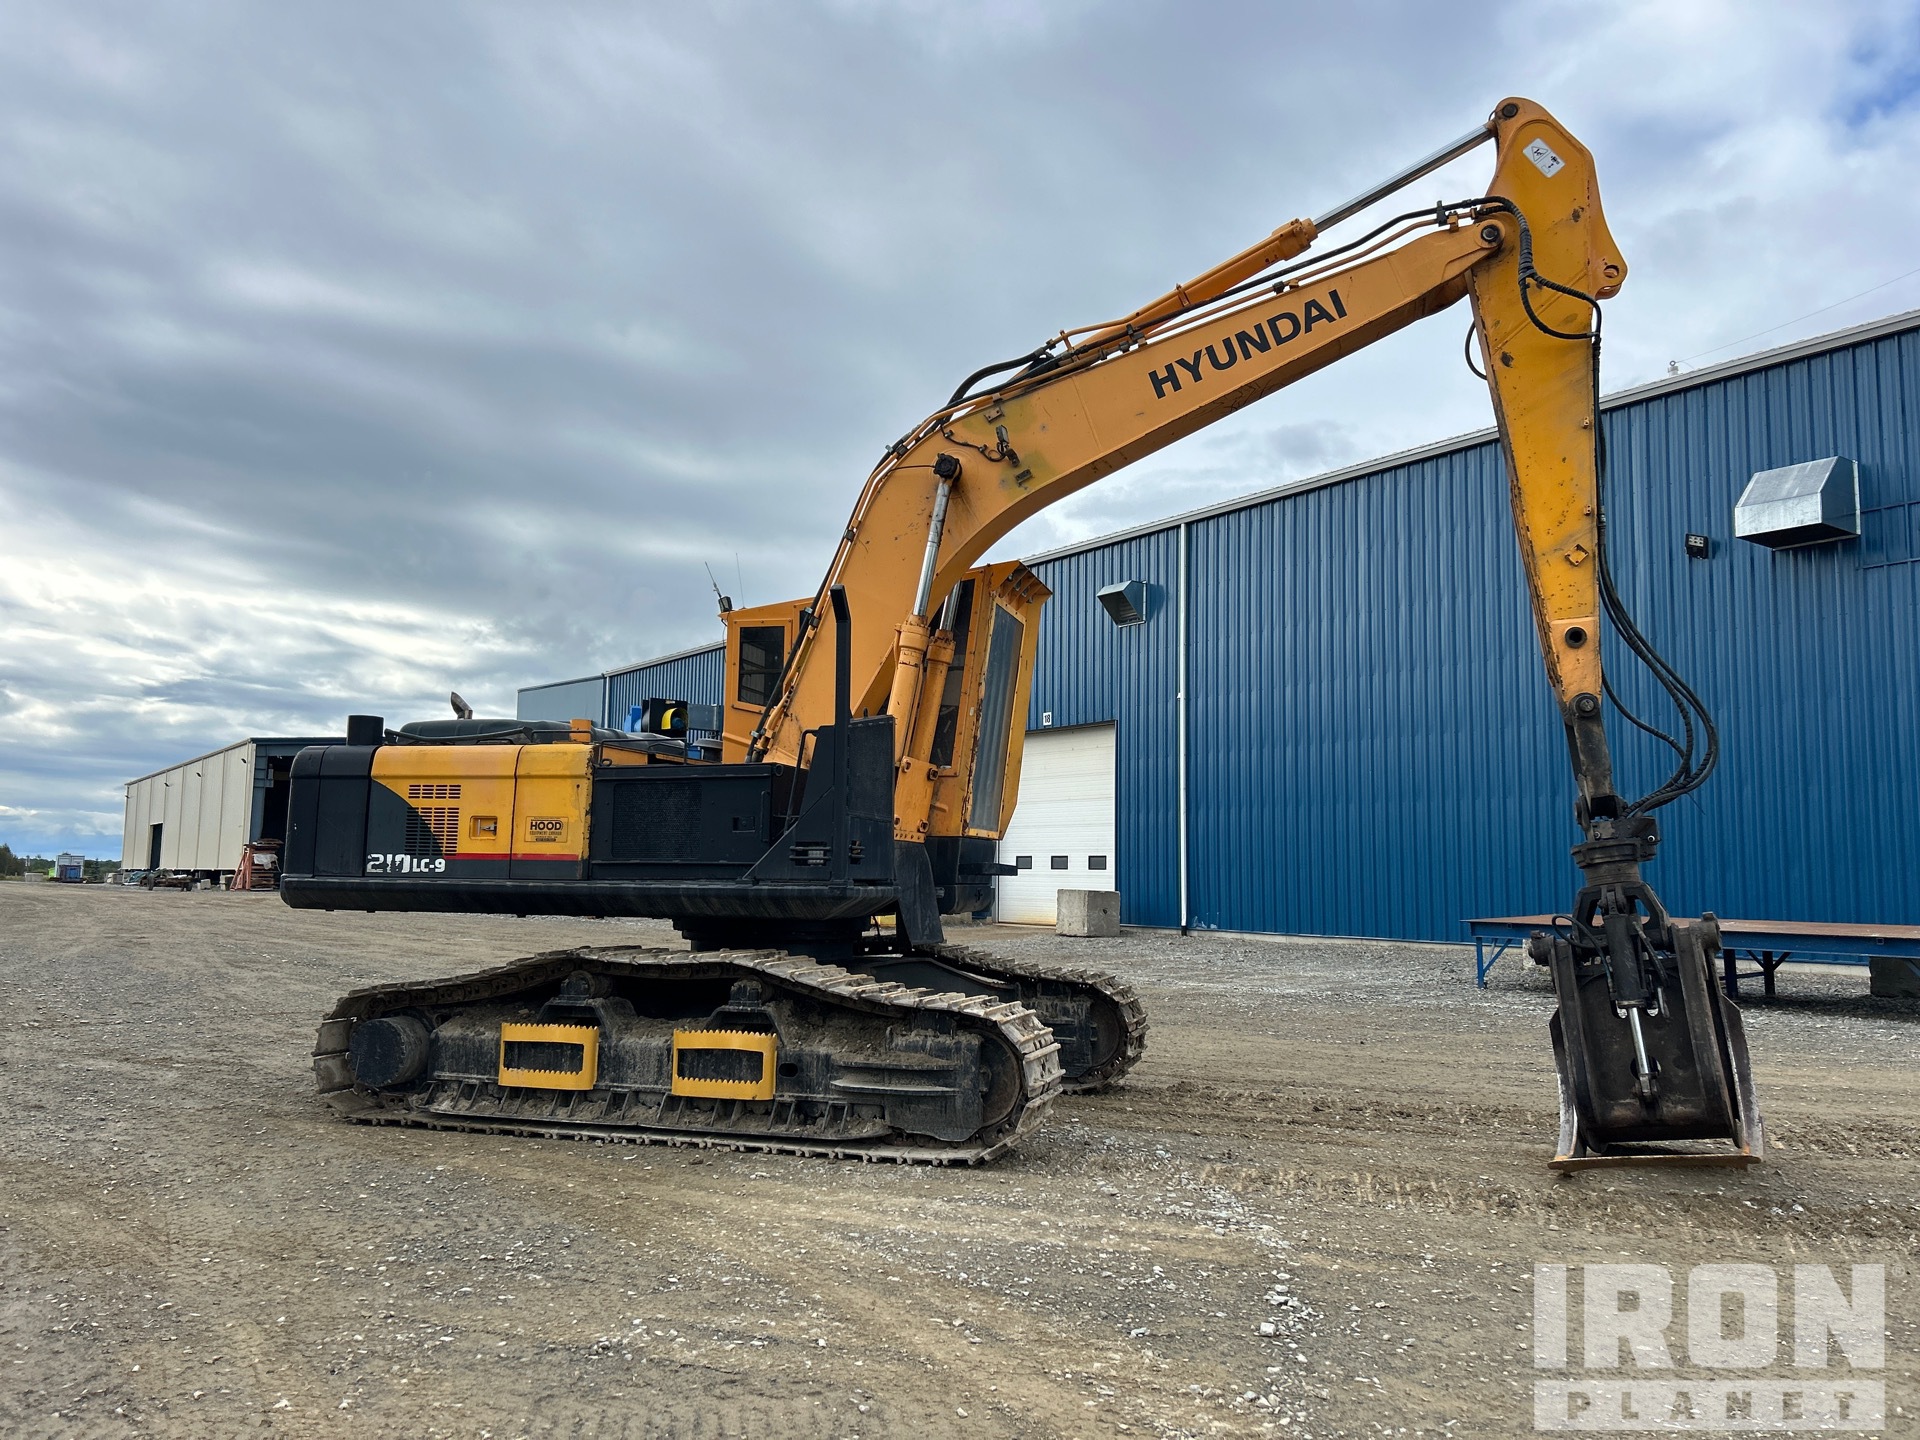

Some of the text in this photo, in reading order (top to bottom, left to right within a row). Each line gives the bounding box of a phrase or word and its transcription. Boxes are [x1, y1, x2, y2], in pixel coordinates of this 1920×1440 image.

[1148, 289, 1348, 399] HYUNDAI
[1044, 714, 1051, 723] 18
[530, 821, 562, 830] HOOD
